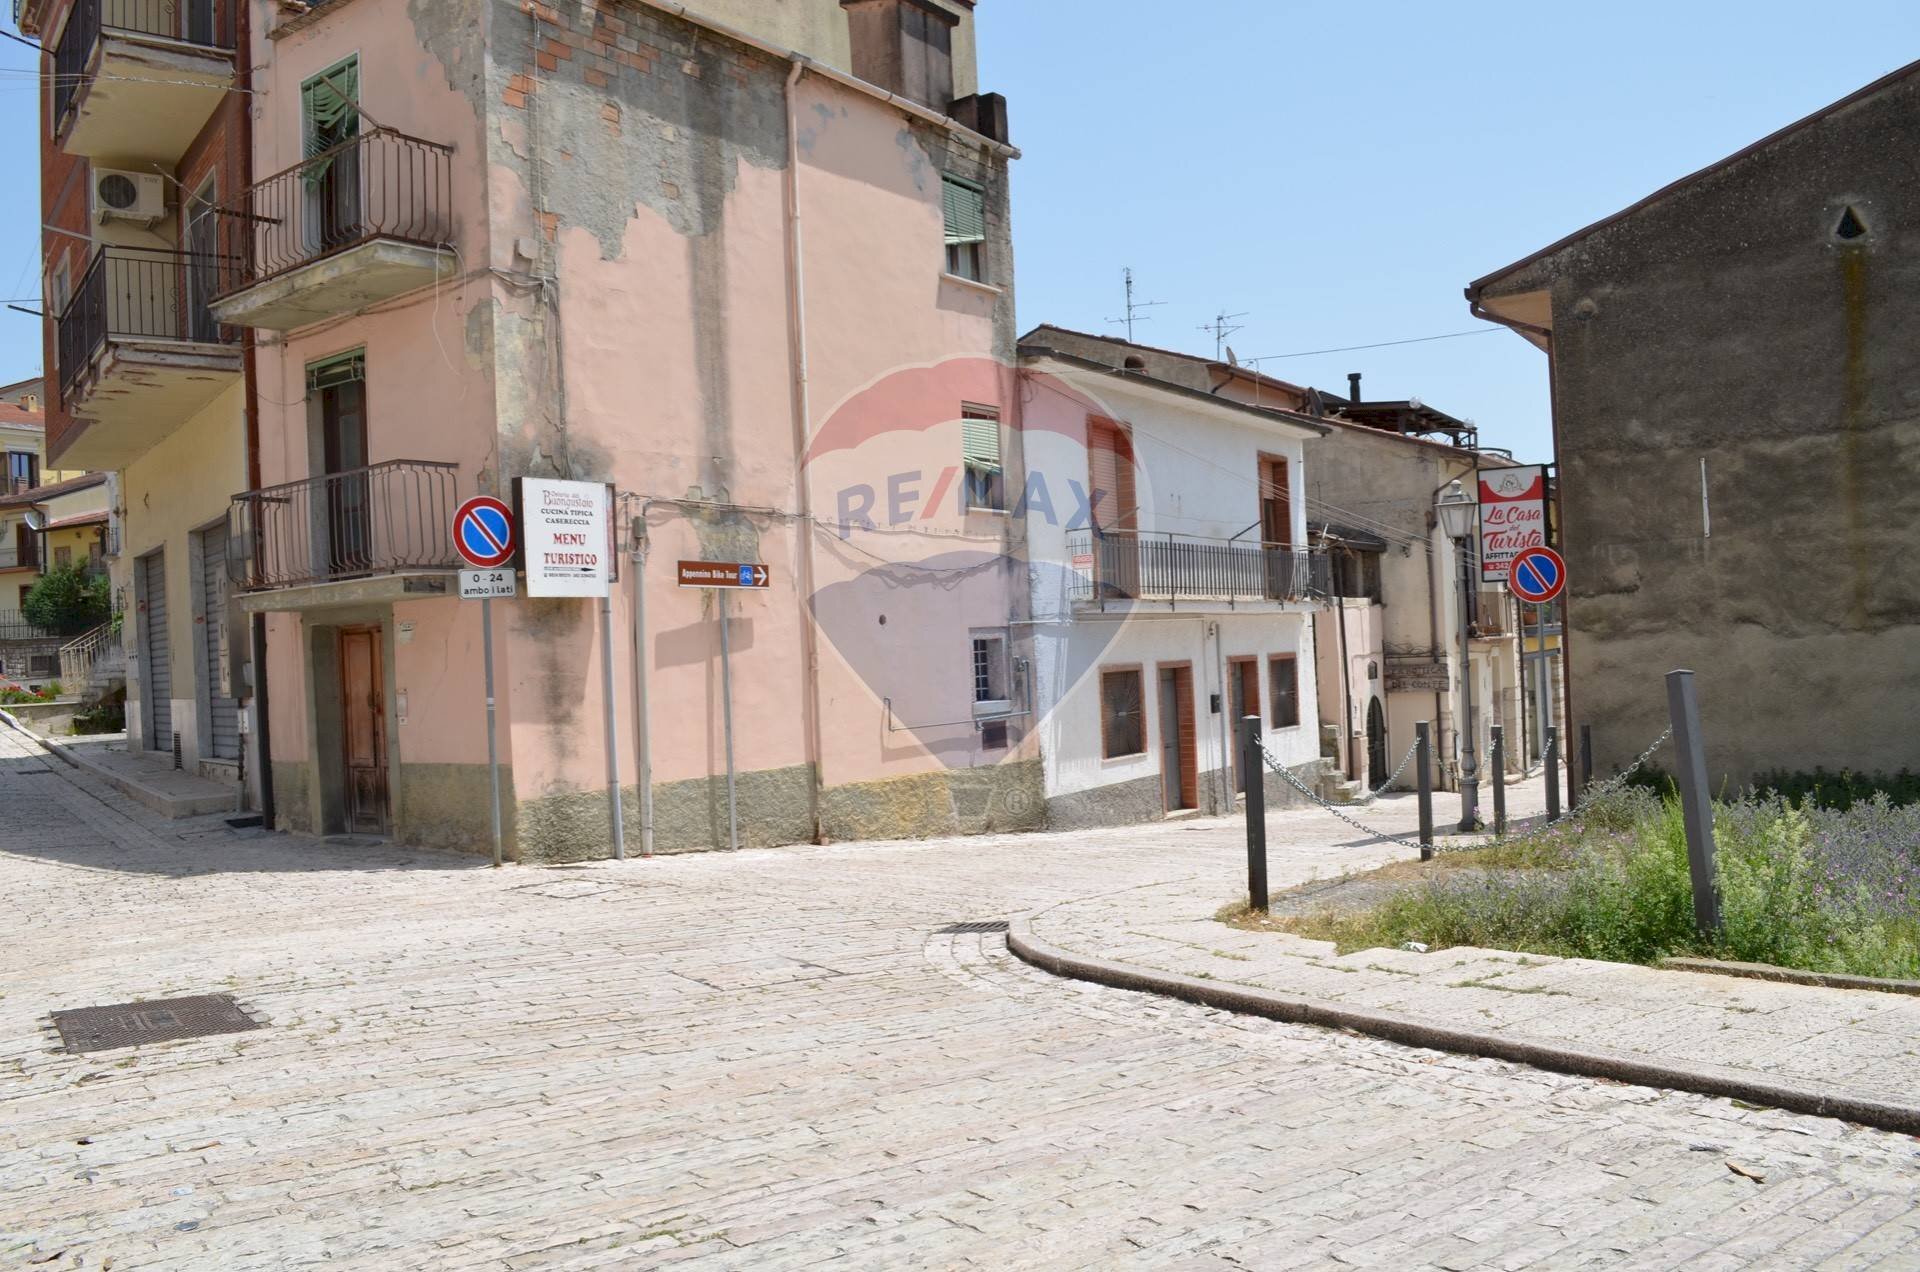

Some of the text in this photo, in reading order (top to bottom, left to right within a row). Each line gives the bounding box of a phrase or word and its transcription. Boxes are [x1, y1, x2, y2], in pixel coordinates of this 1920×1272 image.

[541, 508, 569, 516] CUCINA
[1484, 506, 1541, 525] La Casa
[545, 518, 590, 526] CASERECCIA
[553, 533, 586, 546] MENU
[1483, 529, 1542, 551] Turista
[544, 553, 597, 565] TURISTICO
[489, 573, 503, 583] 24
[682, 569, 711, 578] Appennino
[712, 570, 724, 578] Bike
[464, 586, 489, 595] ambo
[497, 586, 514, 594] lati
